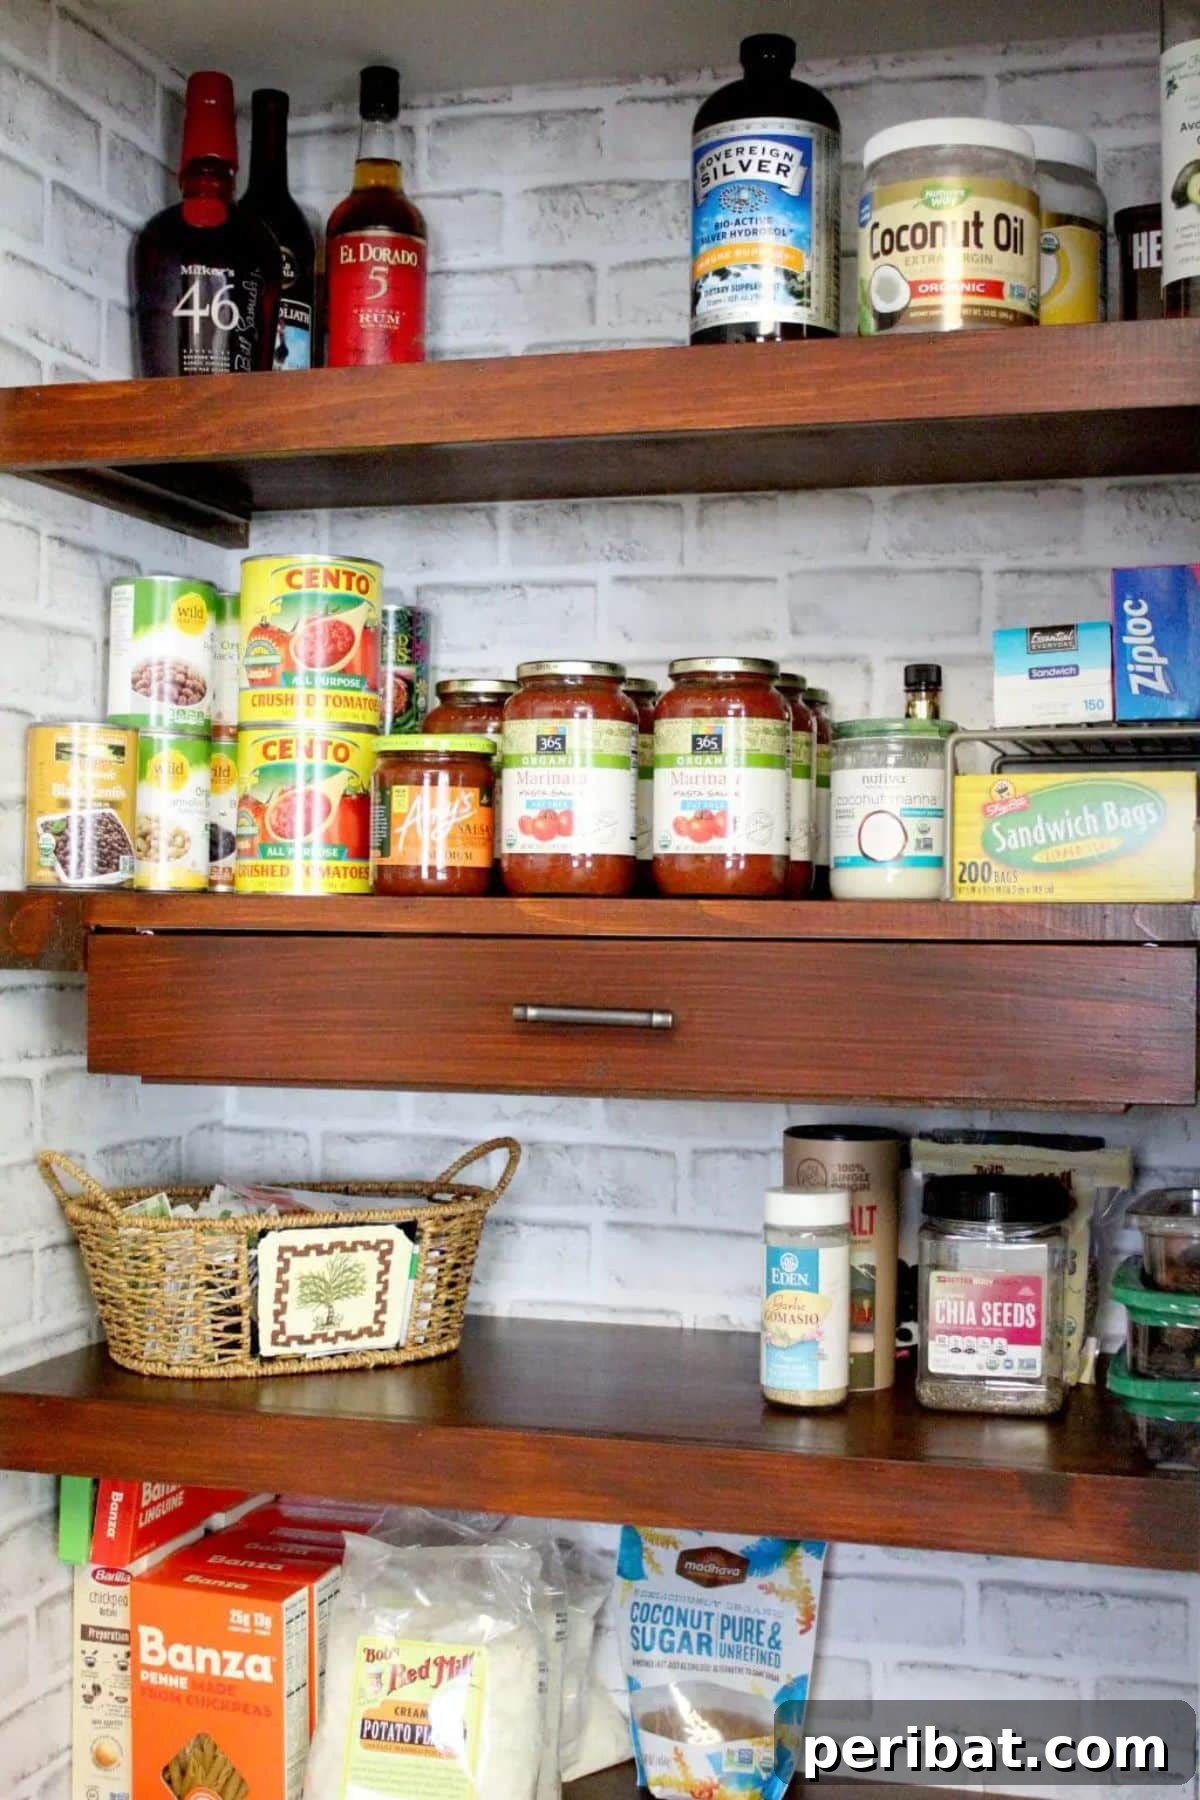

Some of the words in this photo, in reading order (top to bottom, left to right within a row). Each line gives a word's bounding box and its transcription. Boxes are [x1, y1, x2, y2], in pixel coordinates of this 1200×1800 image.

[700, 146, 794, 173] SOVEREIGN
[701, 160, 791, 188] SILVER
[715, 216, 773, 232] BIO-ACTI
[730, 228, 787, 238] HYDROOL
[993, 212, 1024, 257] Oil
[340, 245, 357, 265] EL
[359, 243, 418, 267] DORADO
[904, 254, 945, 267] EXTRA
[963, 253, 993, 265] RGIN
[365, 265, 389, 301] 5
[918, 283, 986, 294] ORNIC
[172, 277, 241, 336] 46
[359, 313, 400, 326] RUM
[285, 567, 370, 595] CENTO
[1122, 597, 1171, 696] Ziploc
[1030, 666, 1077, 679] Sandwich
[251, 693, 316, 707] CRUSHD
[1084, 699, 1105, 711] 150
[261, 738, 351, 764] CENTO
[539, 737, 562, 750] 365
[695, 737, 718, 750] 365
[521, 756, 574, 766] ORGANI
[676, 755, 727, 767] ORGAN
[670, 771, 740, 785] Marina
[896, 793, 937, 807] anna
[991, 804, 1099, 853] Sandwich
[1101, 800, 1159, 832] Bags
[266, 846, 286, 857] ALL
[304, 865, 370, 880] OMATOES
[957, 861, 993, 884] 200
[994, 871, 1018, 884] BAGS
[837, 1163, 866, 1173] 100%
[771, 1267, 809, 1287] EDEN
[935, 1299, 977, 1326] CHIA
[981, 1301, 1036, 1329] SEEDS
[106, 1490, 124, 1540] Banza
[138, 1489, 185, 1529] LINGUINE
[206, 1553, 285, 1572] Banza
[683, 1560, 741, 1578] madhava
[95, 1569, 130, 1584] Barilla
[182, 1572, 249, 1591] Banza
[630, 1601, 715, 1632] COCONUT
[88, 1626, 129, 1643] Preparation
[630, 1625, 714, 1657] SUGAR
[719, 1612, 767, 1647] PURE
[767, 1621, 782, 1651] &
[137, 1623, 274, 1684] Banza
[718, 1641, 782, 1669] UNREFINED
[139, 1669, 189, 1691] PENNE
[387, 1656, 431, 1696] Red
[430, 1650, 476, 1689] Mill
[185, 1694, 273, 1719] CHICKPEAS
[394, 1705, 429, 1719] CREAM
[362, 1719, 412, 1744] POTATO
